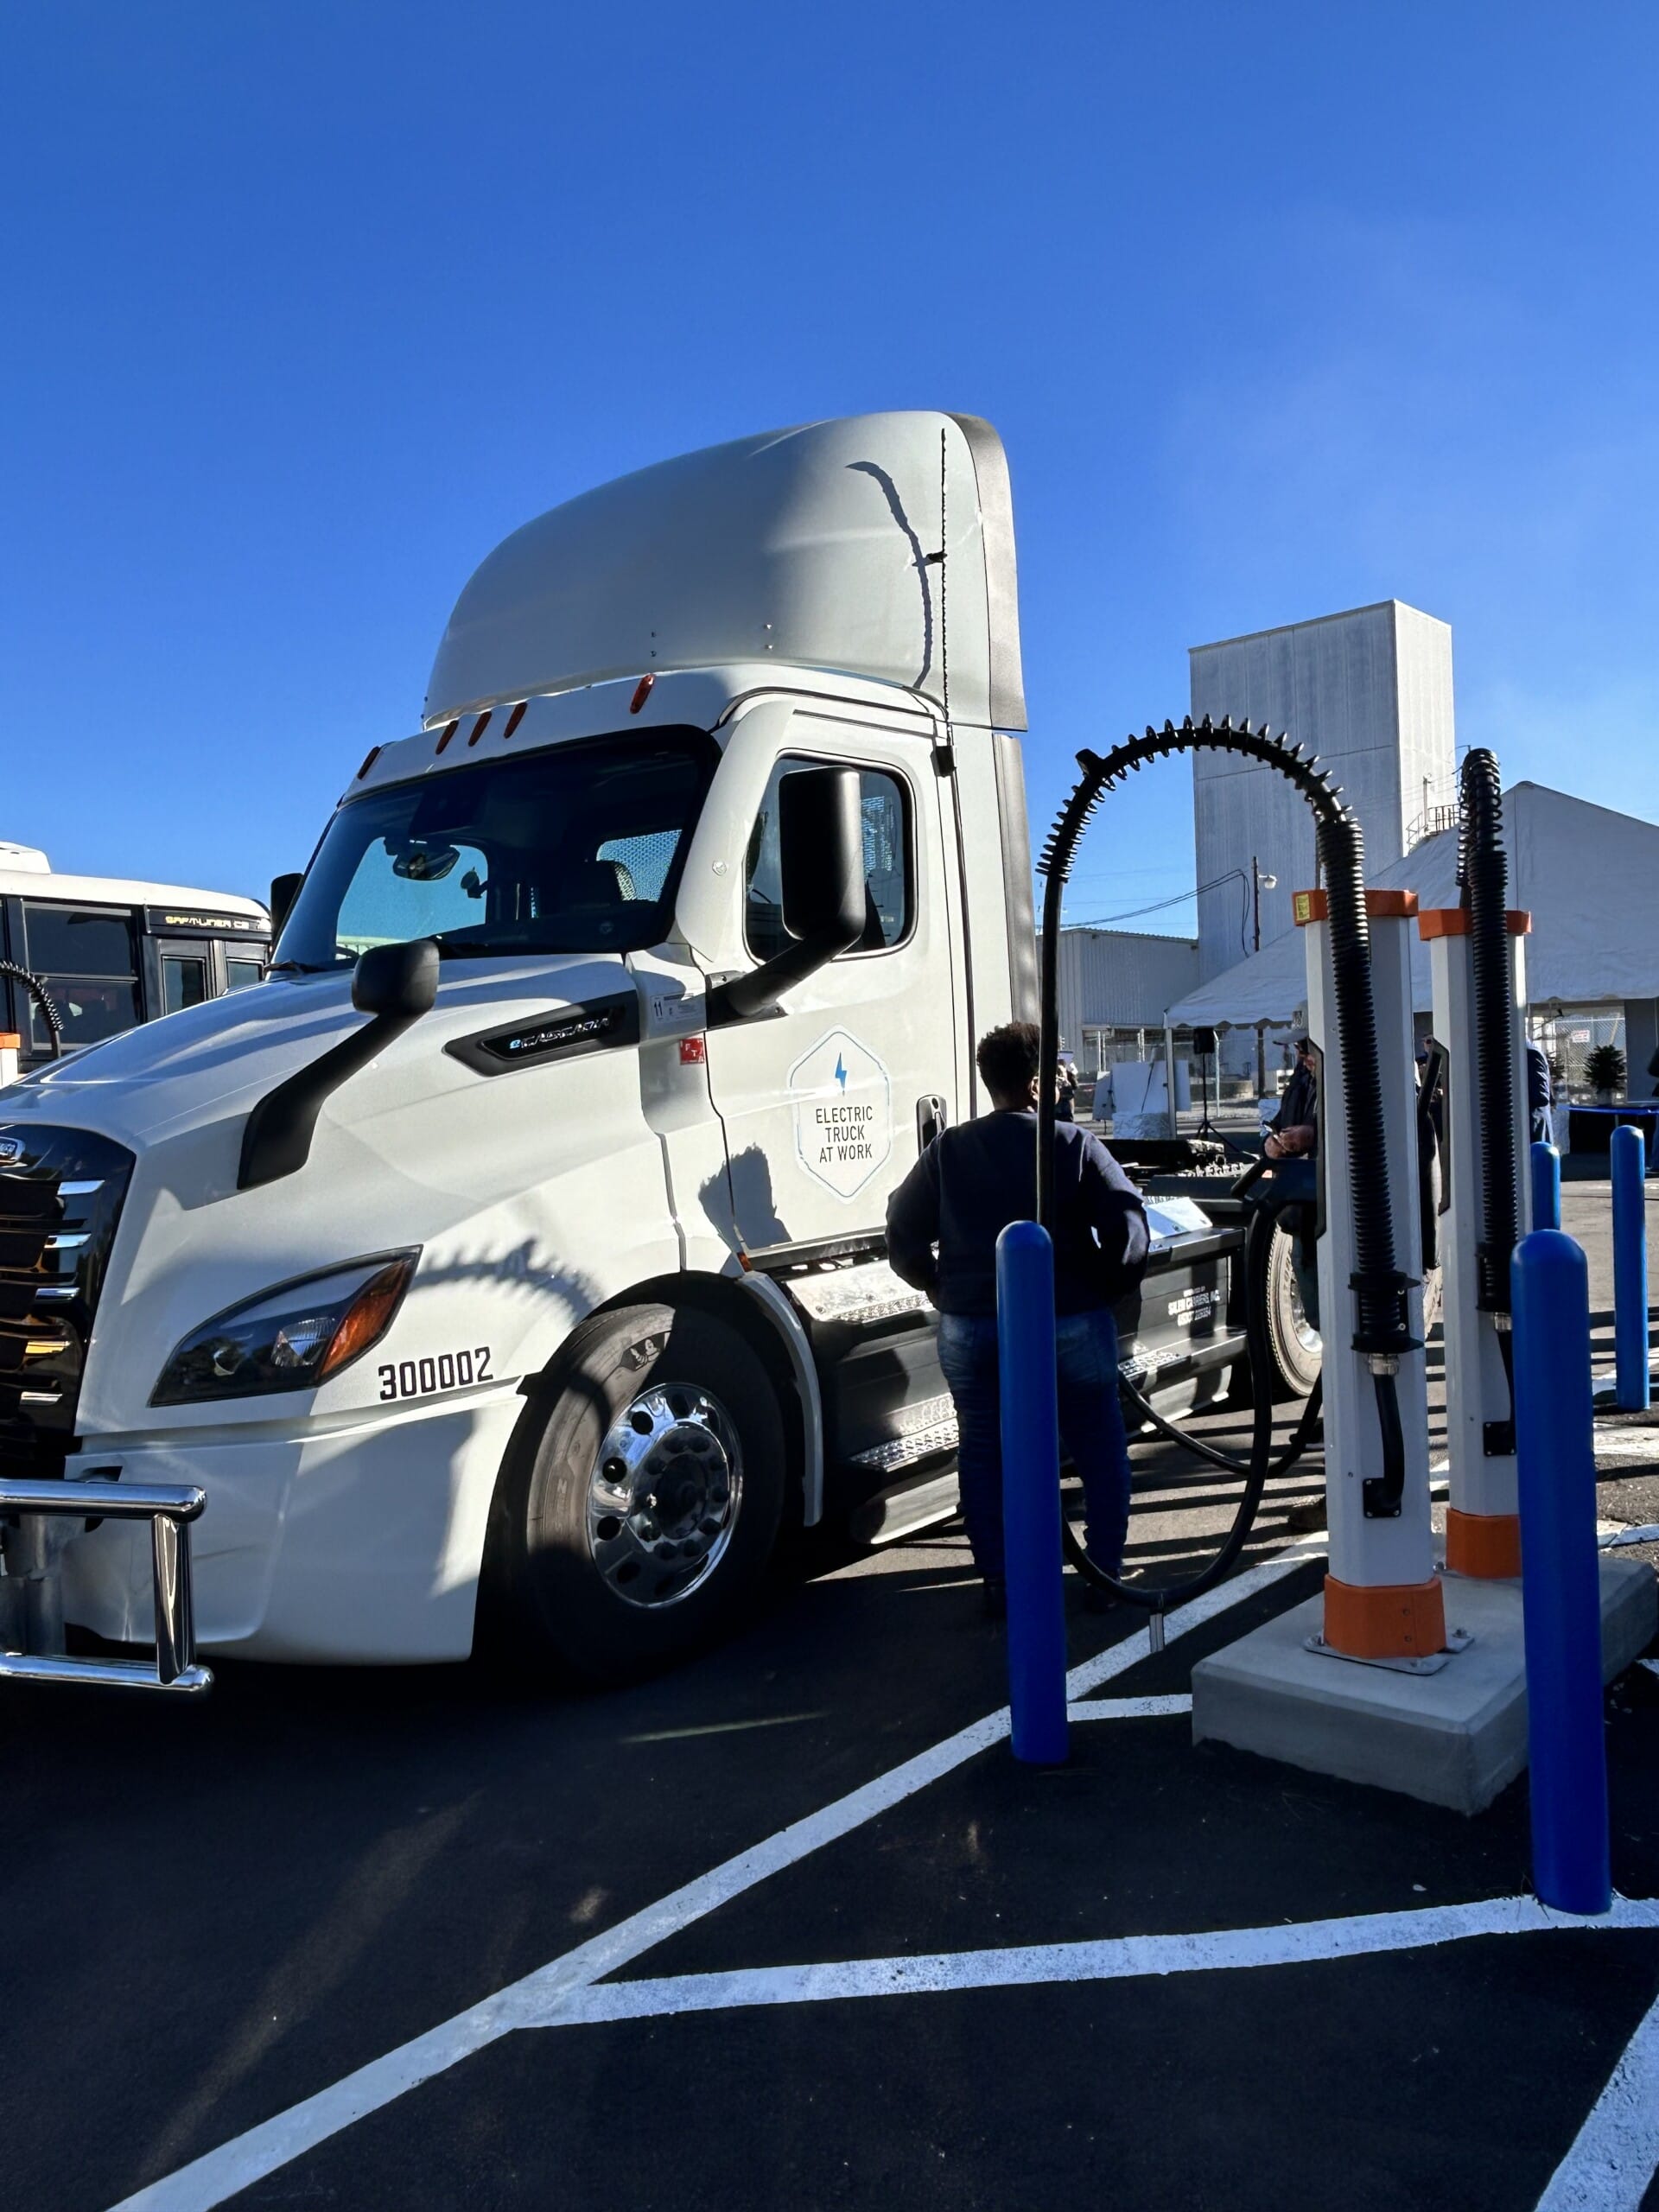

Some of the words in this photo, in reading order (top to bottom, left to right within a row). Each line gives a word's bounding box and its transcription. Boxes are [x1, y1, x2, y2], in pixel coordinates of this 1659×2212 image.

[816, 1105, 873, 1123] ELECTRIC
[824, 1124, 865, 1143] TRUCK
[819, 1147, 833, 1163] AT
[837, 1143, 873, 1161] WORK
[378, 1345, 494, 1402] 300002
